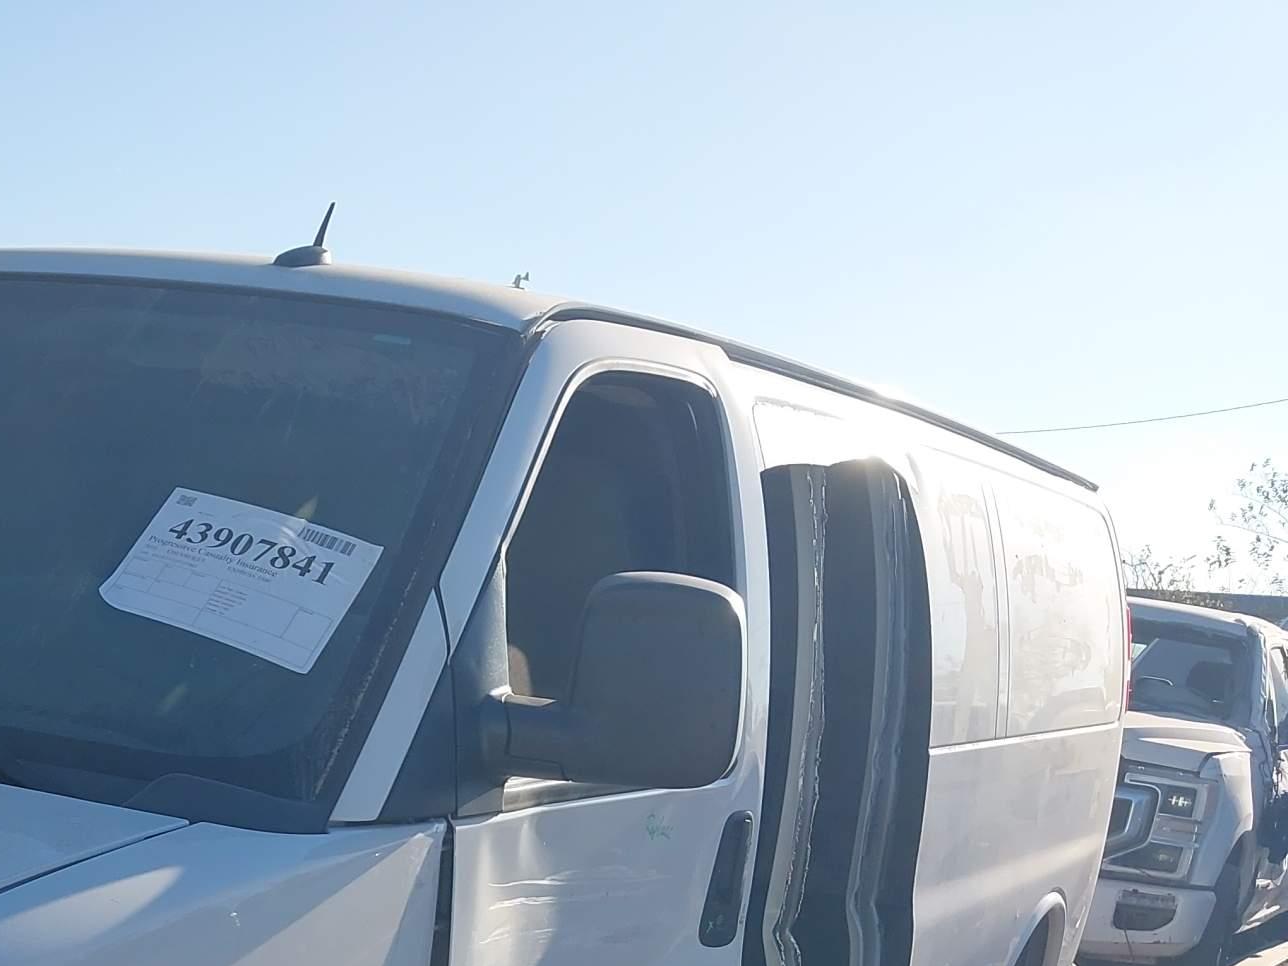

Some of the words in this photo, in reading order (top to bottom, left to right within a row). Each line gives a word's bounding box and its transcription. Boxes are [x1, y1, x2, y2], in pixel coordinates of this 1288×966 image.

[150, 535, 195, 554] Progressive
[198, 548, 236, 564] Casualty
[237, 558, 278, 577] Insurance
[168, 518, 335, 586] 43907841
